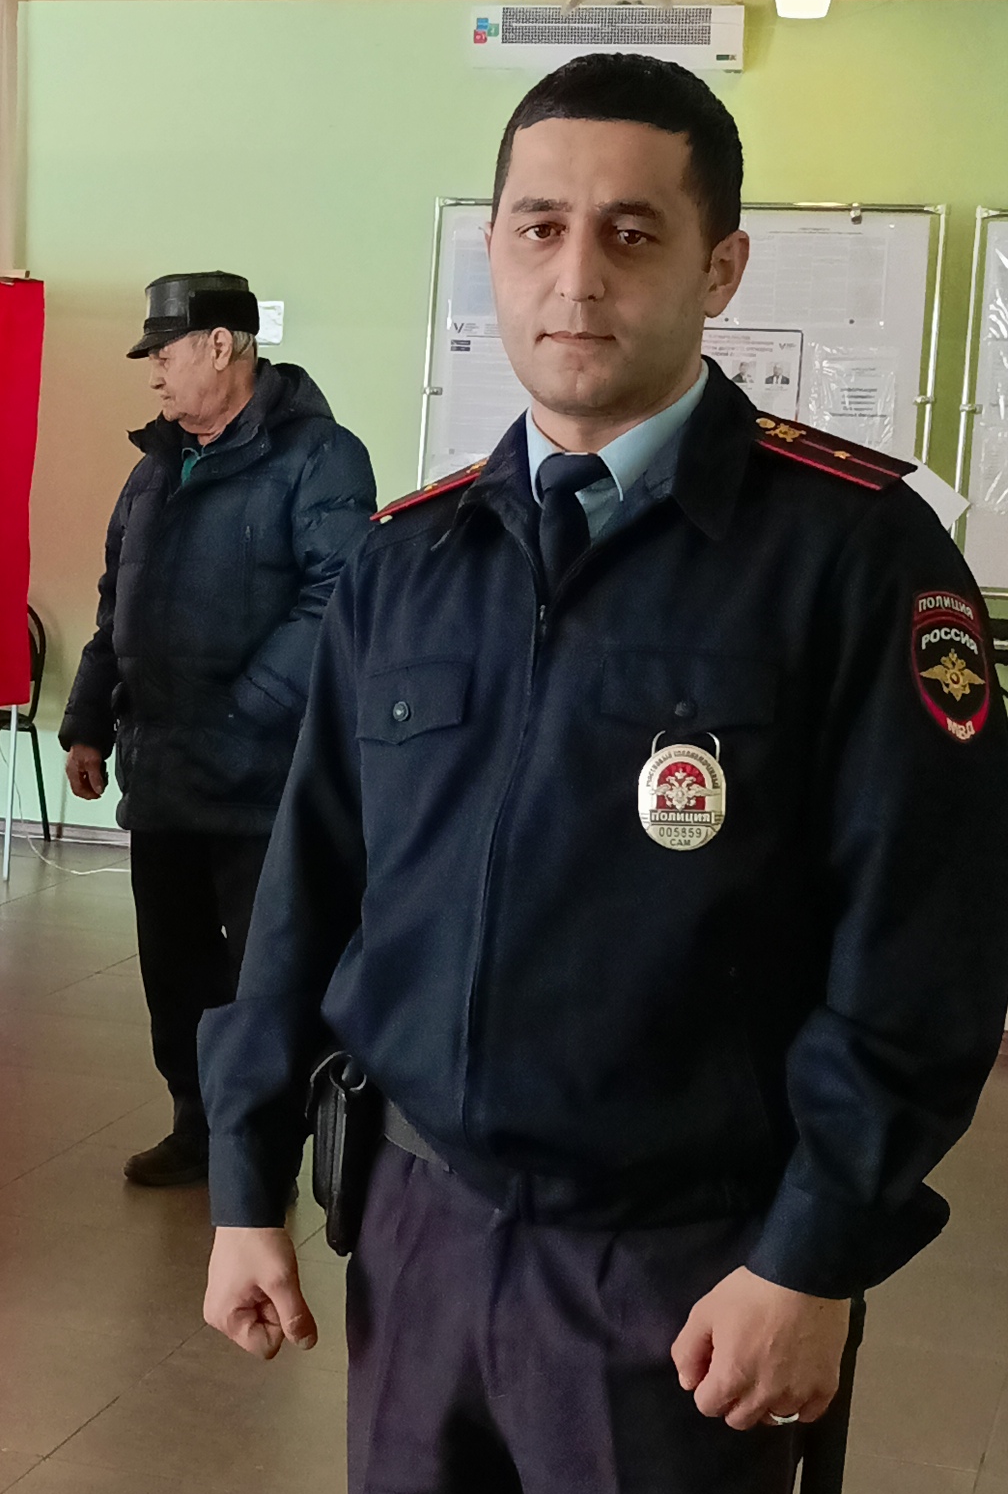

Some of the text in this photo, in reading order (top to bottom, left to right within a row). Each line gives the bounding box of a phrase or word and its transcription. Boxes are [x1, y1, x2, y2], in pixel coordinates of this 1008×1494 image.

[918, 595, 974, 620] ПОЛИЦИЯ
[921, 627, 979, 655] РОССИЯ
[946, 717, 976, 740] МВД
[652, 811, 711, 823] ПОЛИЦИЯ
[658, 827, 702, 838] 005859
[669, 838, 691, 846] САМ
